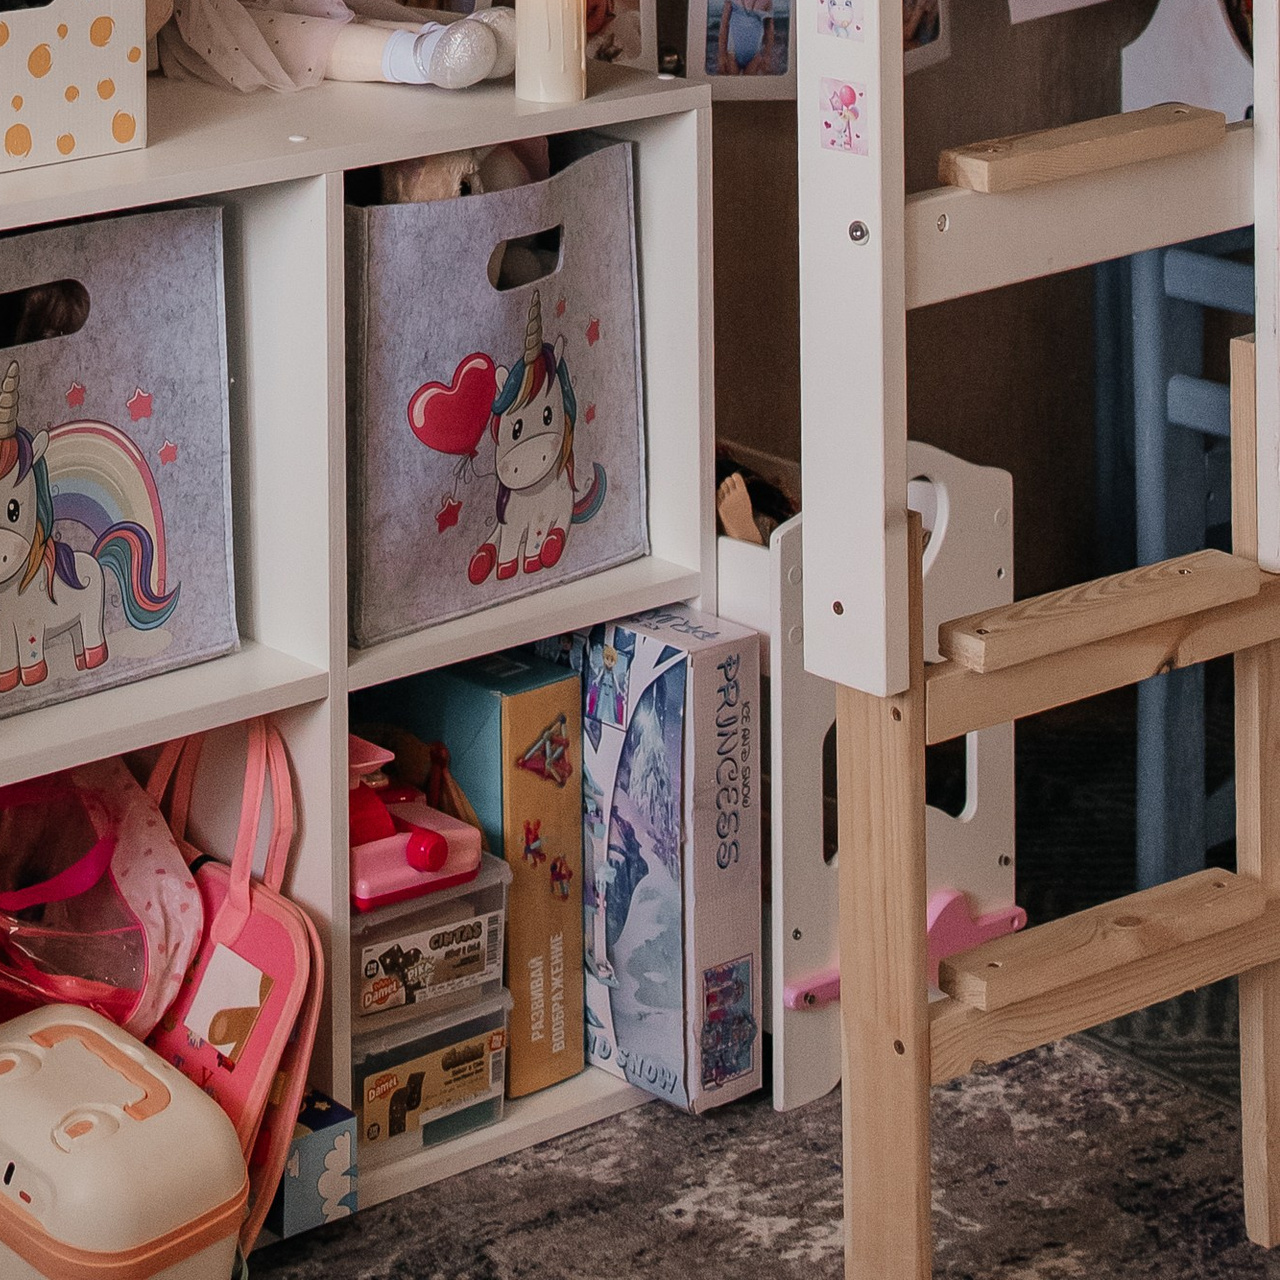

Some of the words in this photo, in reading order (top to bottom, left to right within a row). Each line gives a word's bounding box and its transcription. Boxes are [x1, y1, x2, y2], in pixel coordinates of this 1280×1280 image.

[743, 701, 751, 725] ICE
[716, 653, 740, 870] PRINCESS
[741, 727, 751, 763] AND
[742, 767, 751, 809] SNOW
[429, 921, 483, 951] CINTAS
[364, 980, 398, 1008] Damel
[528, 955, 545, 1042] РАЗВИВАЙ
[550, 931, 565, 1054] ВООБРАЖЕНИЕ
[368, 1075, 398, 1102] Damel
[617, 1048, 678, 1094] SNOW
